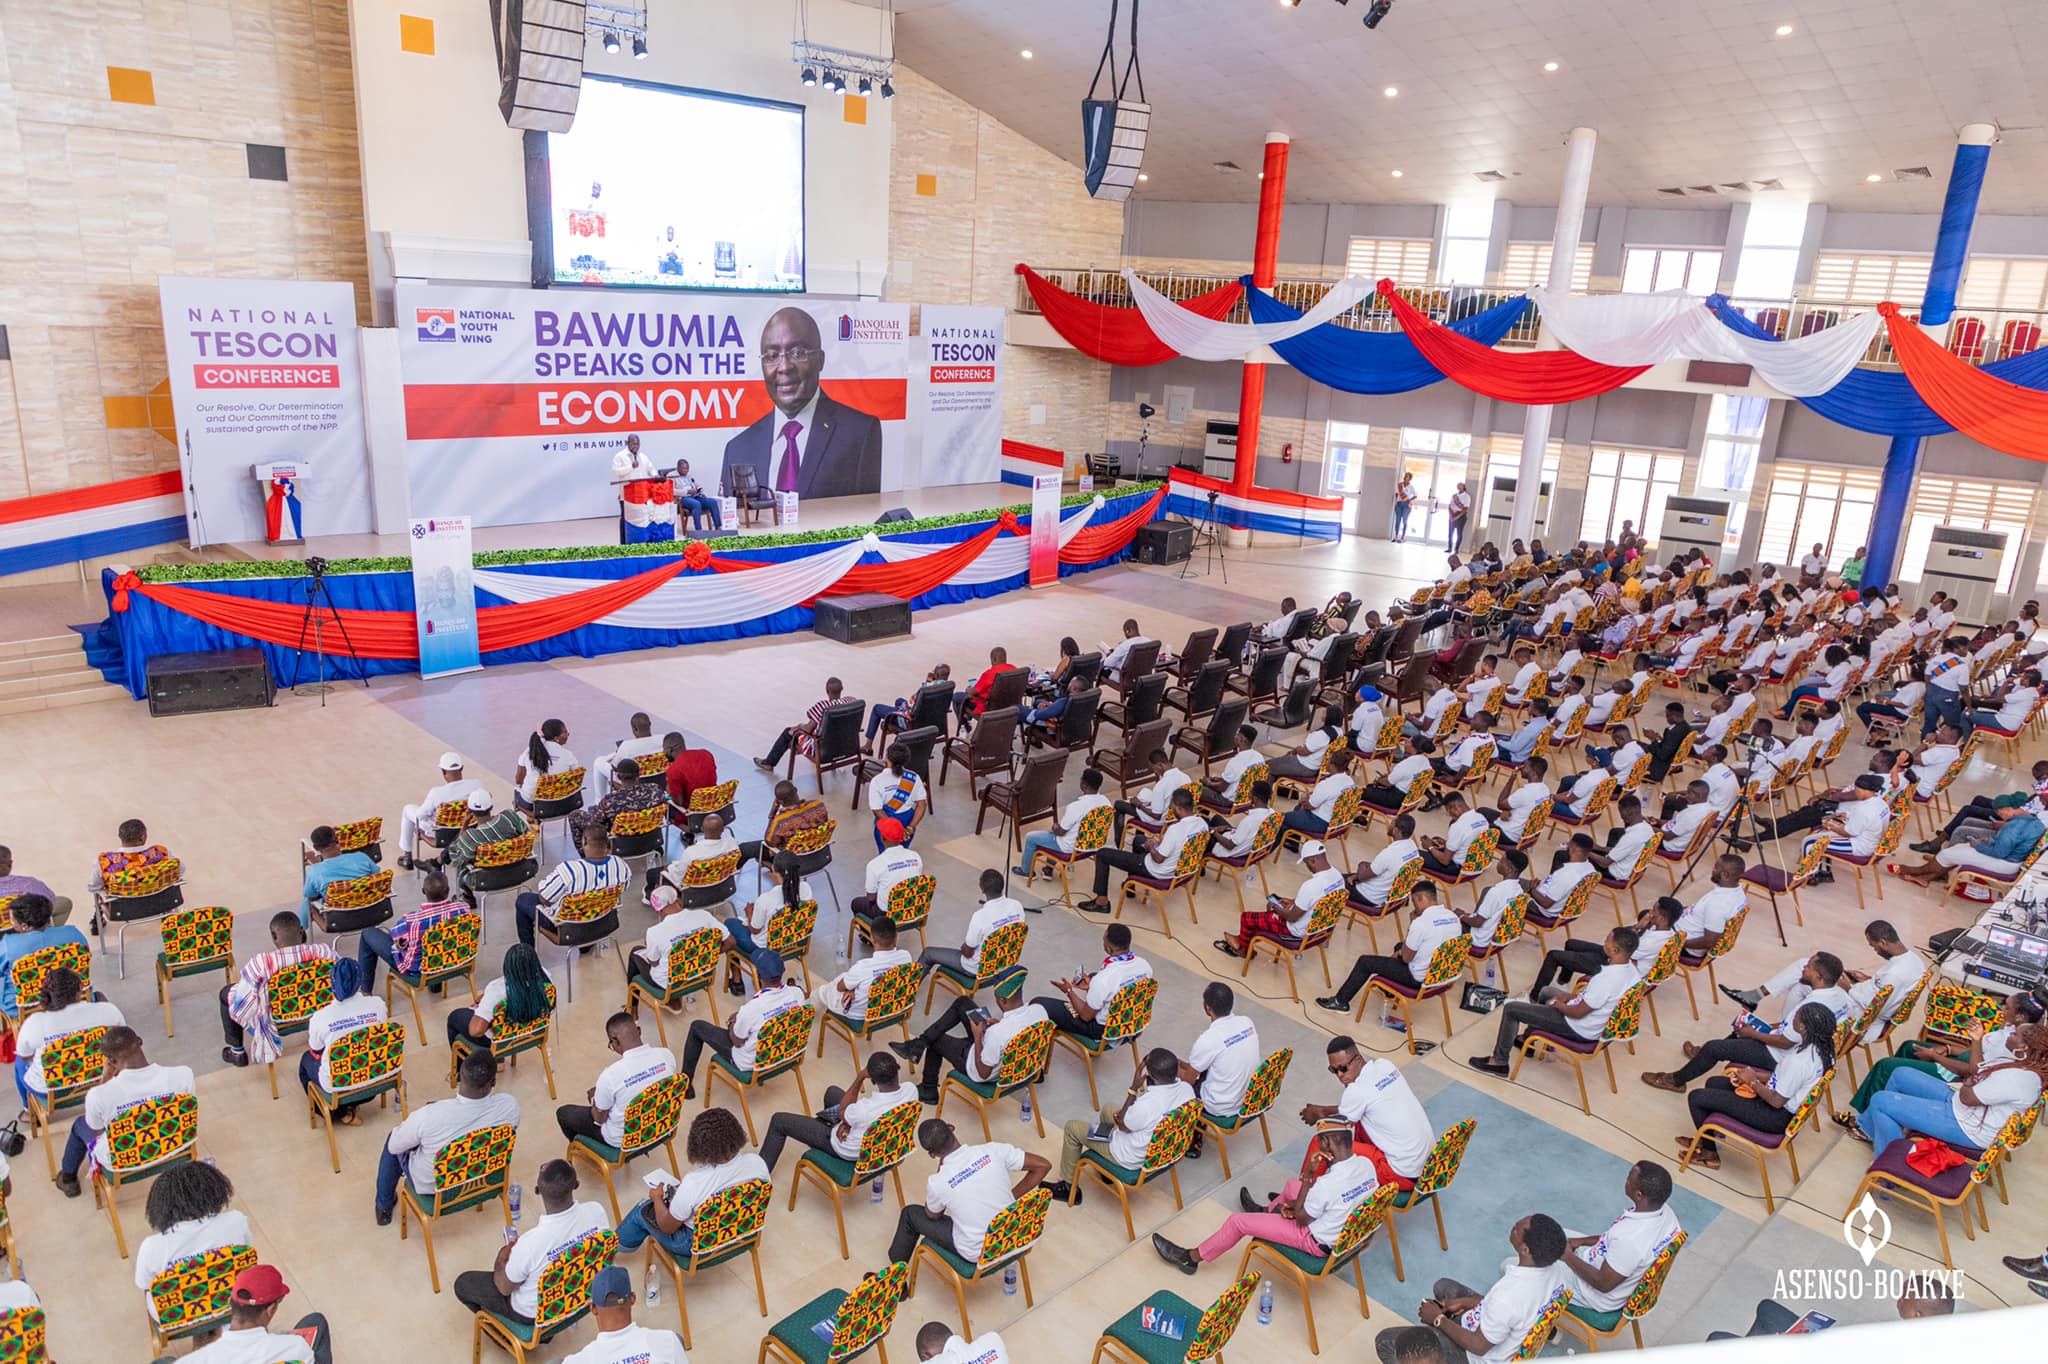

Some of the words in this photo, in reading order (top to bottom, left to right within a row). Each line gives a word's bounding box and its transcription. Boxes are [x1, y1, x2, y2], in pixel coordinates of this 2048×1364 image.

[188, 308, 333, 325] NATIONAL
[459, 310, 515, 320] NATIONAL
[460, 322, 498, 331] YOUTH
[534, 310, 745, 348] BAWUMIA
[854, 319, 899, 330] DANQUAH
[461, 335, 492, 344] WING
[854, 330, 903, 340] INSTITUTE
[932, 328, 995, 339] NATIONAL
[190, 331, 337, 358] TESCON
[931, 343, 996, 362] TESCON
[535, 352, 644, 377] SPEAKS
[651, 352, 692, 375] ON
[699, 353, 745, 375] THE
[203, 369, 332, 384] CONFERENCE
[934, 369, 991, 380] CONFERENCE
[196, 404, 214, 412] Our
[258, 403, 276, 411] Our
[278, 402, 343, 411] Determination
[537, 387, 745, 426] ECONOMY
[205, 414, 226, 423] and
[228, 414, 246, 422] Our
[248, 413, 309, 422] Commitment
[310, 413, 320, 421] to
[322, 412, 337, 420] the
[205, 425, 254, 433] sustained
[255, 424, 289, 434] growth
[291, 423, 301, 431] of
[302, 423, 318, 431] the
[328, 1017, 356, 1028] NATIONAL
[356, 1012, 377, 1021] TESCON
[329, 1020, 364, 1032] CONFERENCE
[117, 1097, 147, 1110] NATIONAL
[547, 1239, 576, 1256] NATIONAL
[622, 1352, 651, 1364] TESCON
